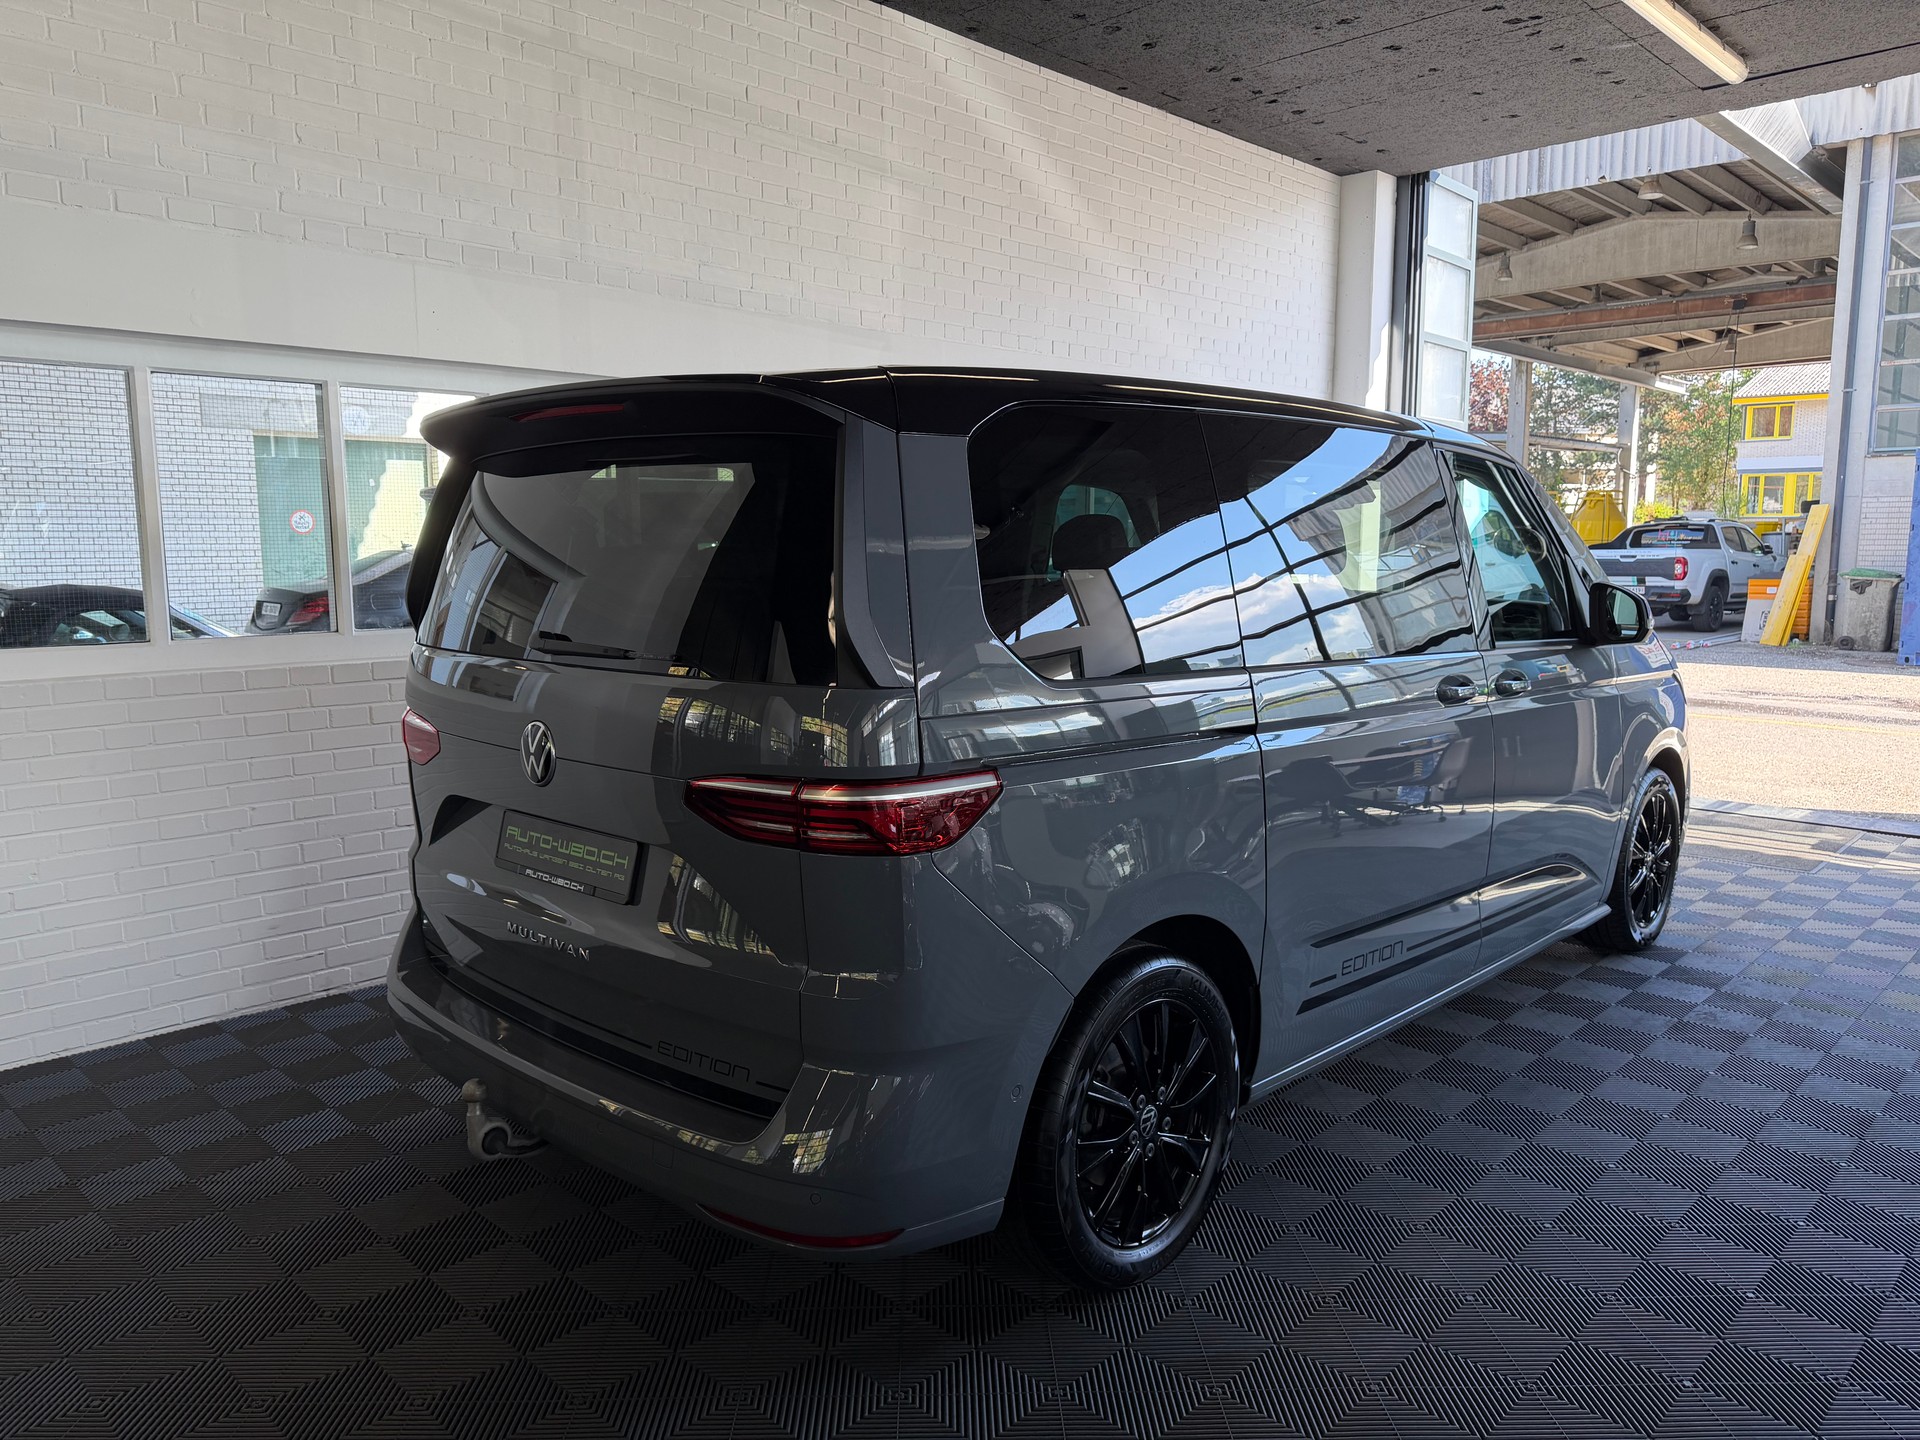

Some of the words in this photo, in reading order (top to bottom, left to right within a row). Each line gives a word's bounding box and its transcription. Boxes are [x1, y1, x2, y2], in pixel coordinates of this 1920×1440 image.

[504, 842, 538, 858] AUTOHAUS
[538, 853, 568, 866] WANGEN
[568, 860, 584, 871] BEI
[585, 865, 613, 878] OLTEN
[613, 872, 625, 882] AG
[506, 825, 629, 869] AUTO-WBO.CH
[507, 921, 590, 961] MULTIVAN
[1341, 940, 1404, 976] EDITION
[657, 1040, 750, 1082] EDITION
